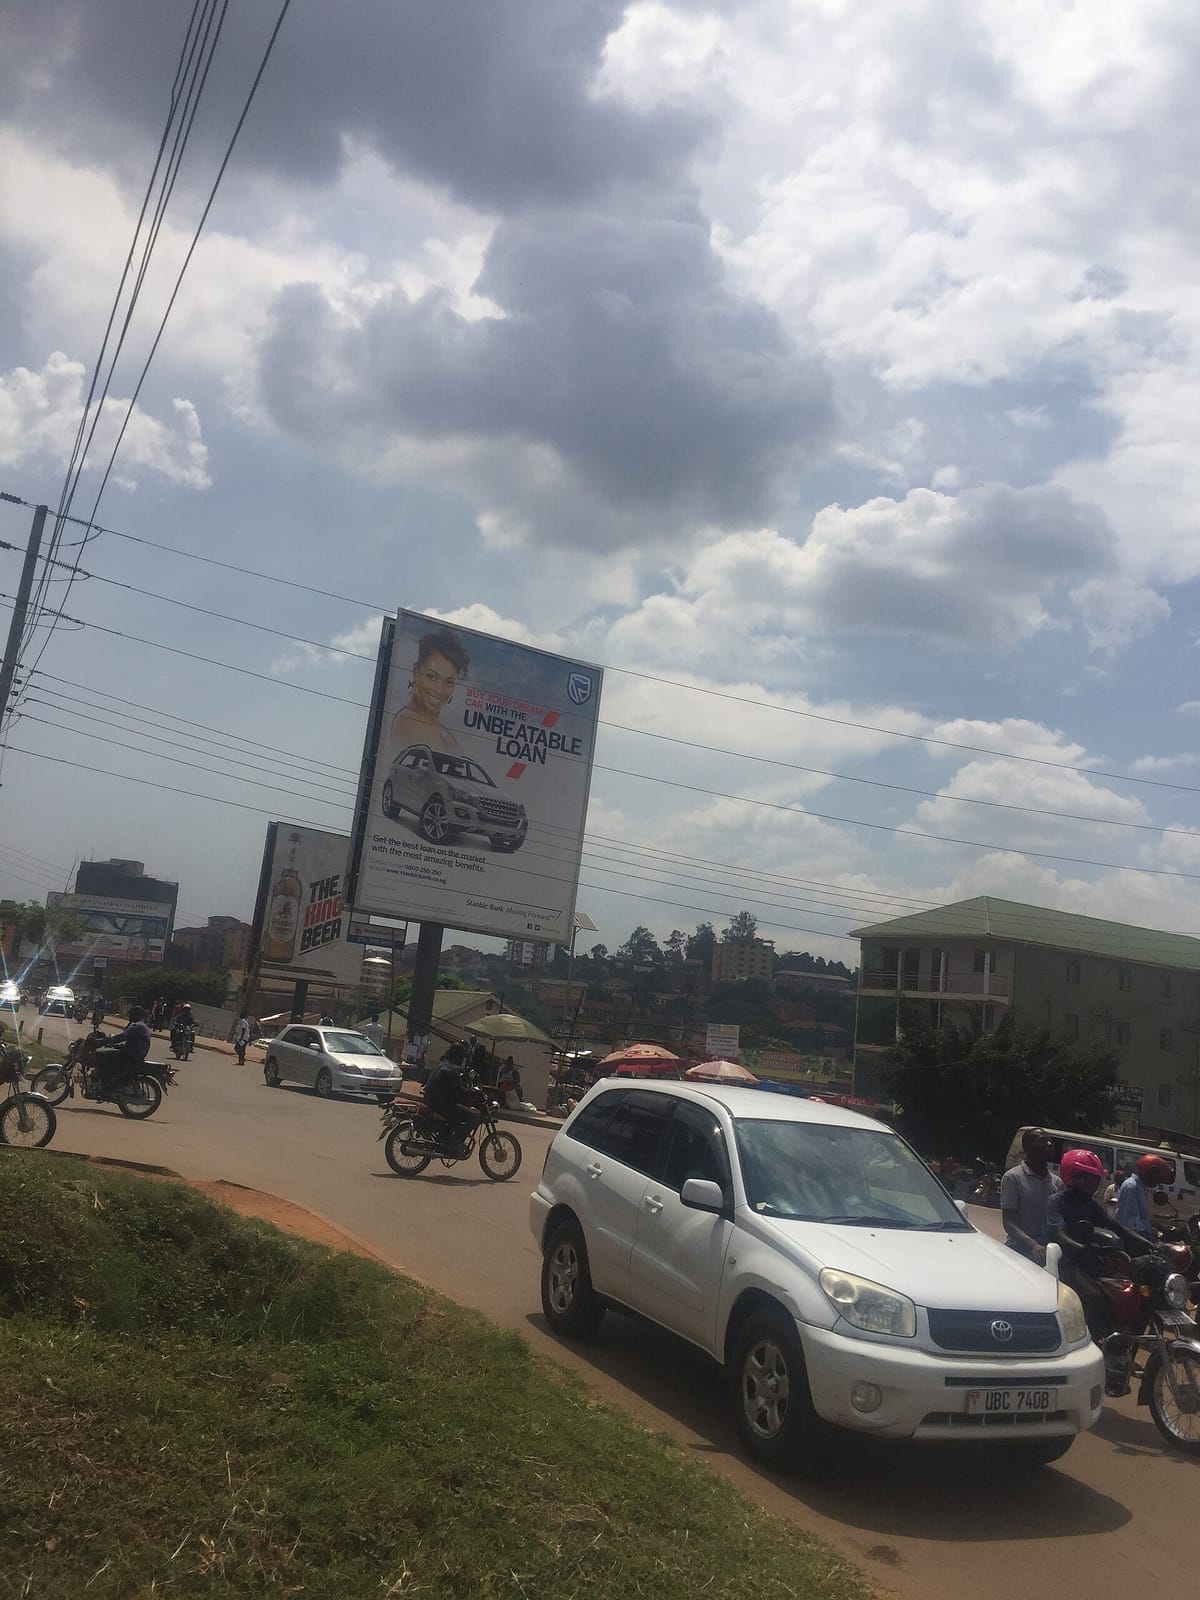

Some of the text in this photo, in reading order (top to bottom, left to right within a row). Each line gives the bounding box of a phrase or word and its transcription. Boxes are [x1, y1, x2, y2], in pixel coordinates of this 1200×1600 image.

[465, 698, 527, 721] CAR WITH THE
[466, 688, 543, 715] BUY YOUR DREAM
[463, 709, 583, 756] UNBEATABLE
[496, 736, 547, 765] LOAN
[371, 844, 388, 854] with
[389, 847, 401, 856] the
[403, 851, 422, 861] most
[424, 855, 454, 868] amazing
[373, 834, 387, 844] Get
[388, 837, 400, 847] the
[402, 840, 419, 851] best
[420, 844, 436, 854] loan
[448, 849, 460, 859] the
[460, 853, 486, 864] market
[309, 874, 341, 903] THE
[304, 896, 342, 928] KING
[466, 899, 488, 910] Stanbic
[489, 903, 505, 912] Bank
[300, 918, 342, 952] BEER
[985, 1391, 1049, 1410] UBC 740B
